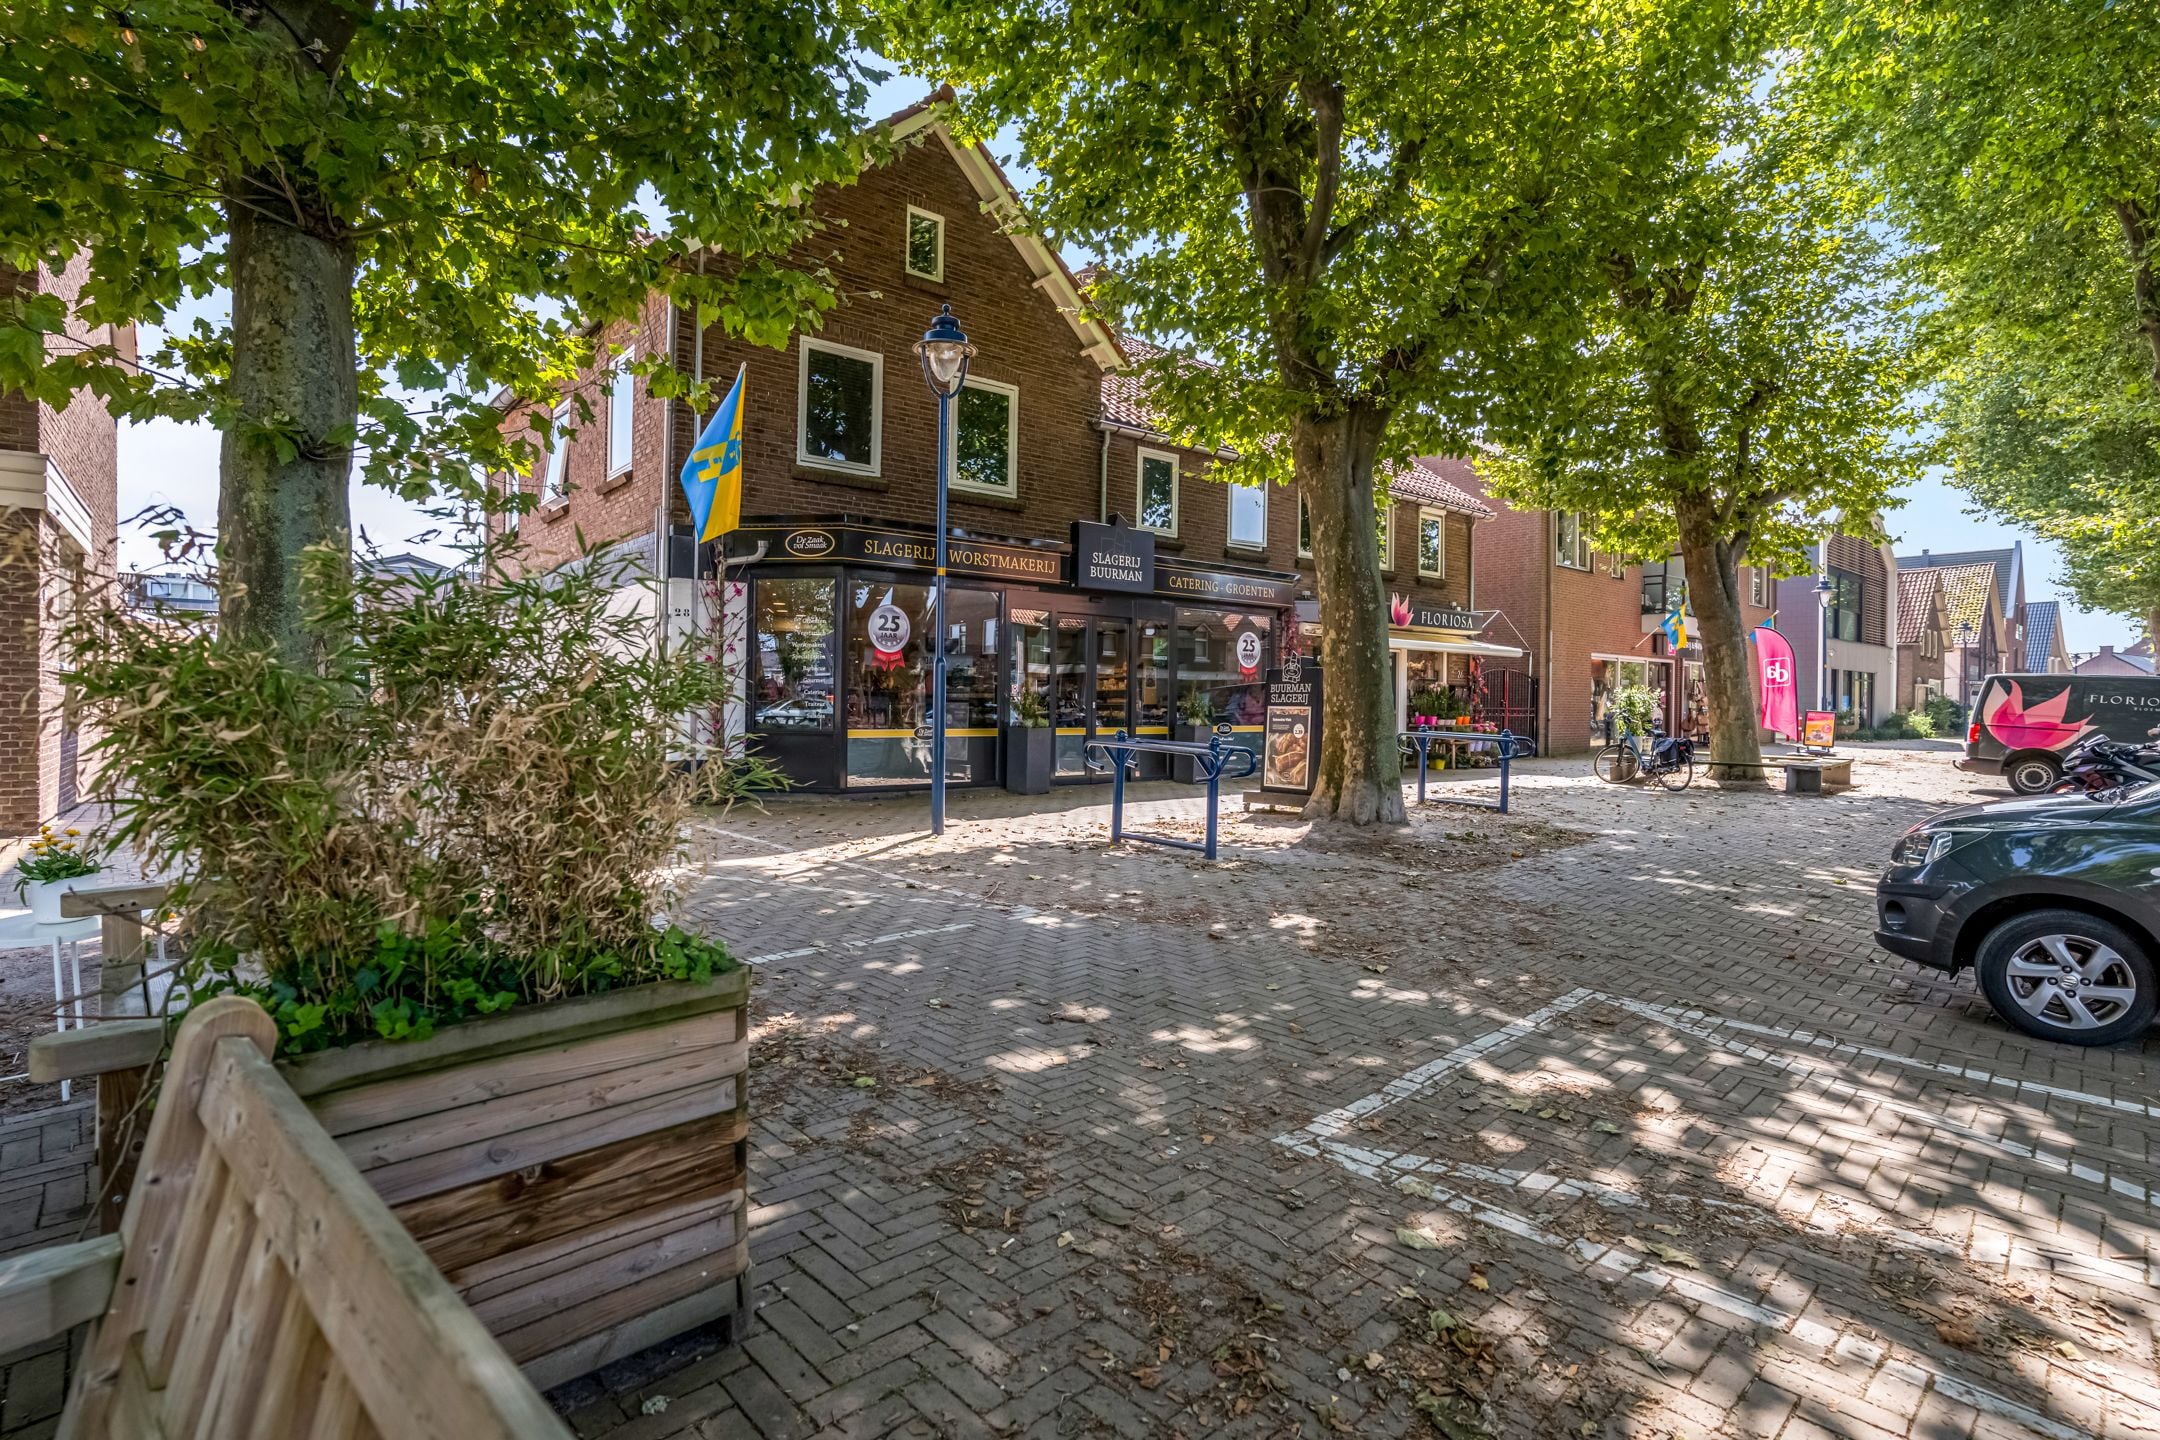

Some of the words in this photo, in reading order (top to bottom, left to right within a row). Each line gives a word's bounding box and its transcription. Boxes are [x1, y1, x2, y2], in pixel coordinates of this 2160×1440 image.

[864, 539, 936, 561] SLAGERIJ
[949, 549, 1056, 574] WORSTMAKERIJ
[1092, 552, 1141, 568] SLAGERIJ
[1090, 566, 1143, 582] BUURMAN
[1169, 576, 1219, 592] CATERING
[1225, 583, 1275, 598] GROENTEN
[674, 607, 690, 617] 28
[1421, 611, 1473, 629] FLORIOSA
[878, 614, 900, 632] 25
[1242, 639, 1256, 652] 25
[1270, 683, 1312, 693] BUURMAN
[1270, 693, 1309, 705] SLAGERIJ
[2089, 694, 2160, 707] FLORIO
